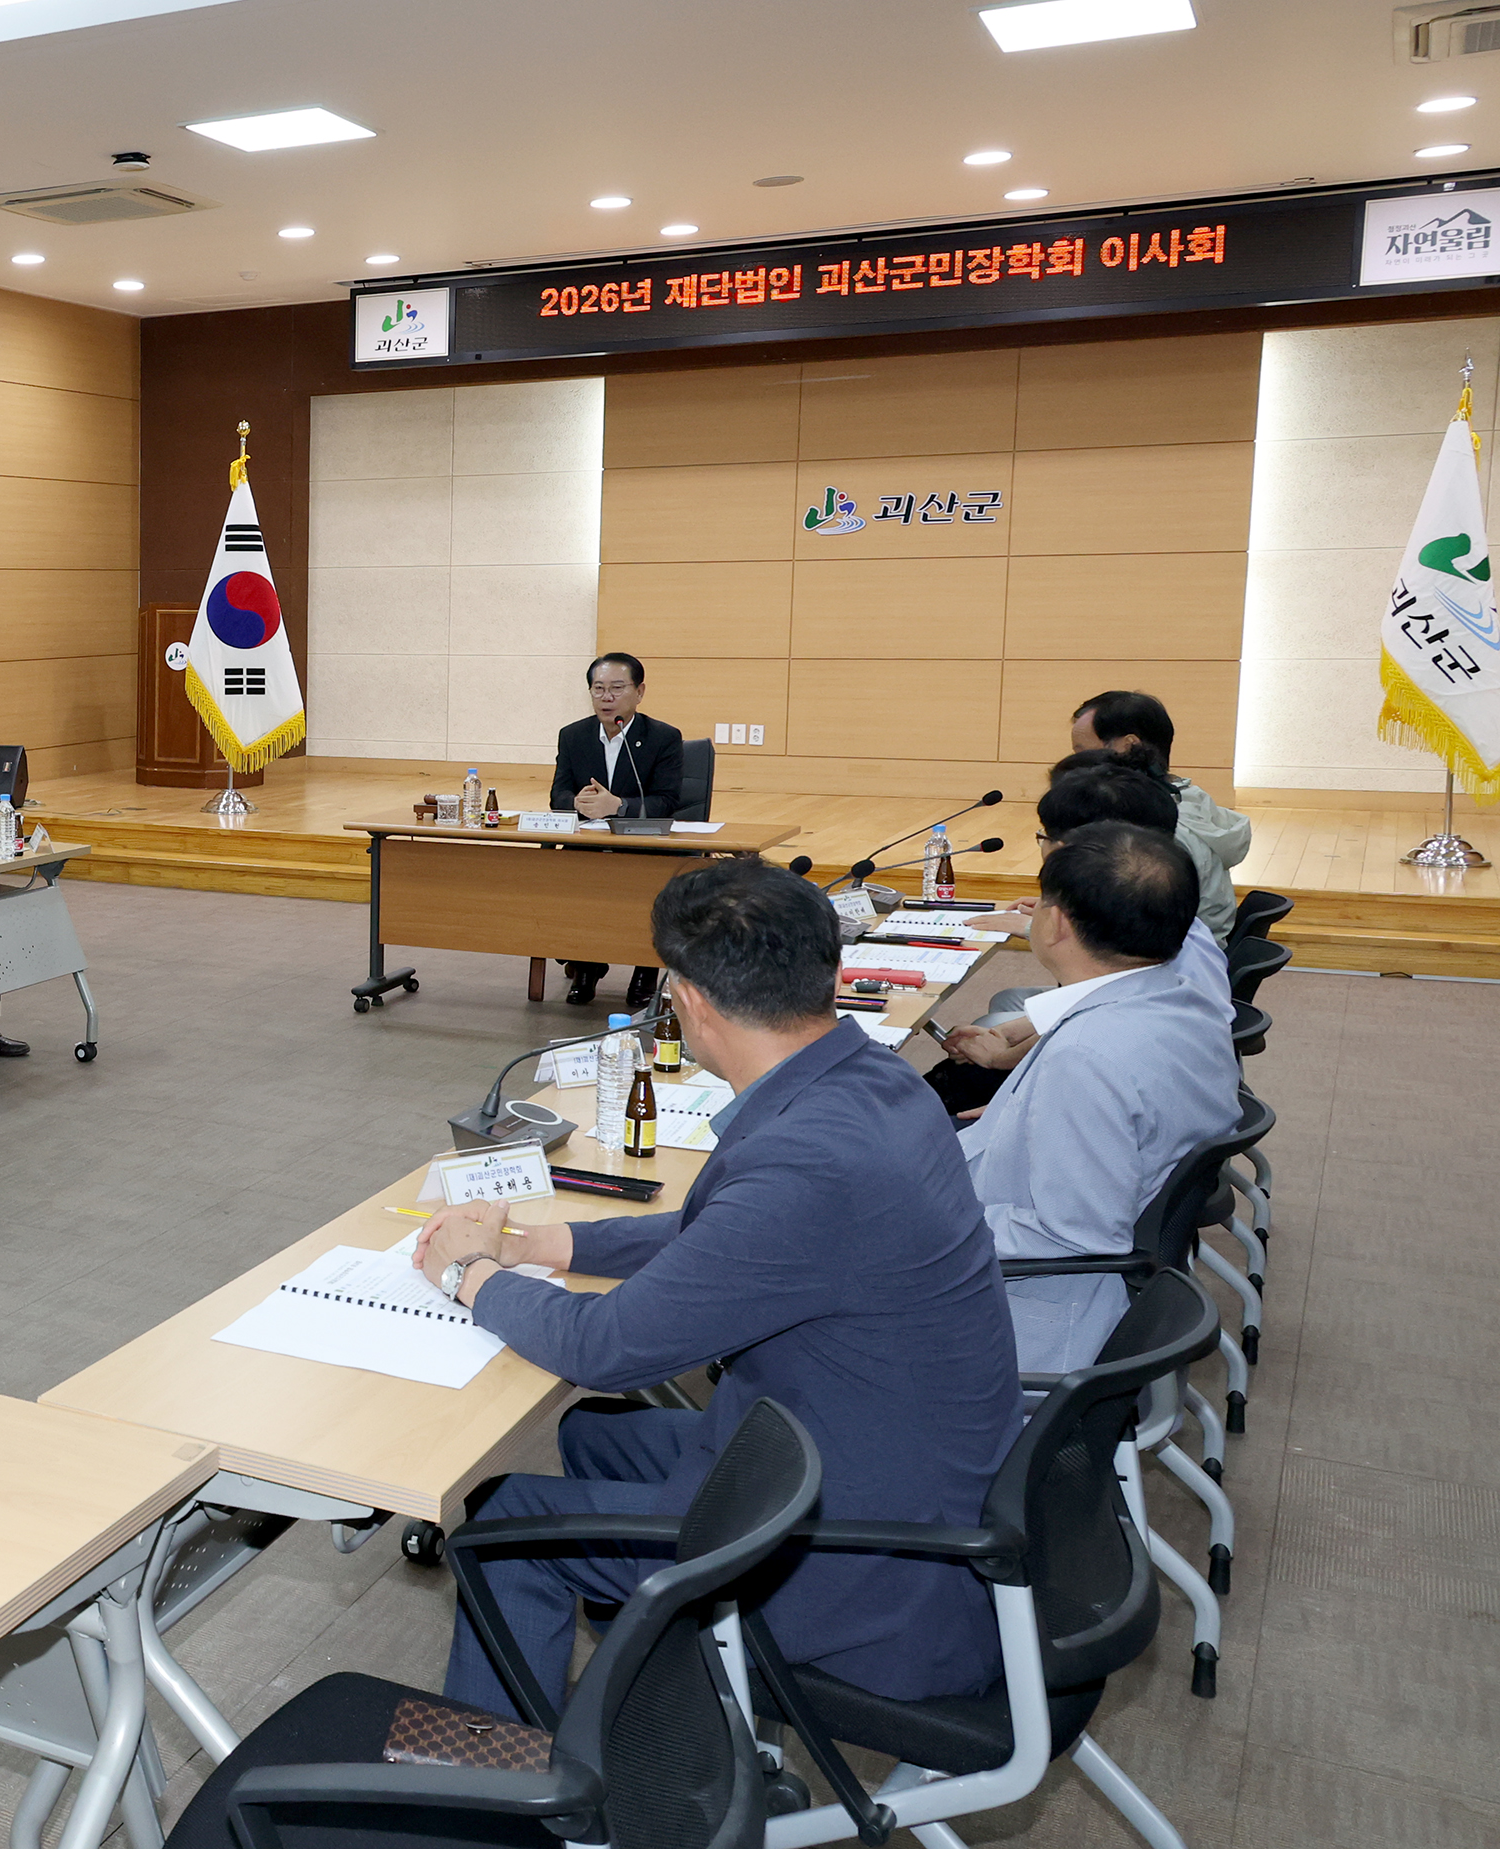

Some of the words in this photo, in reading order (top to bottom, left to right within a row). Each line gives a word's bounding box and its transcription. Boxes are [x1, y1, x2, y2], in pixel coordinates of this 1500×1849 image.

[1385, 225, 1492, 256] 자연울림
[540, 277, 652, 317] 2026년
[664, 264, 802, 309] 재단법인
[815, 237, 1086, 297] 괴산군민장학회
[1099, 224, 1227, 272] 이사회
[374, 336, 429, 353] 괴산군
[872, 490, 1003, 526] 괴산군
